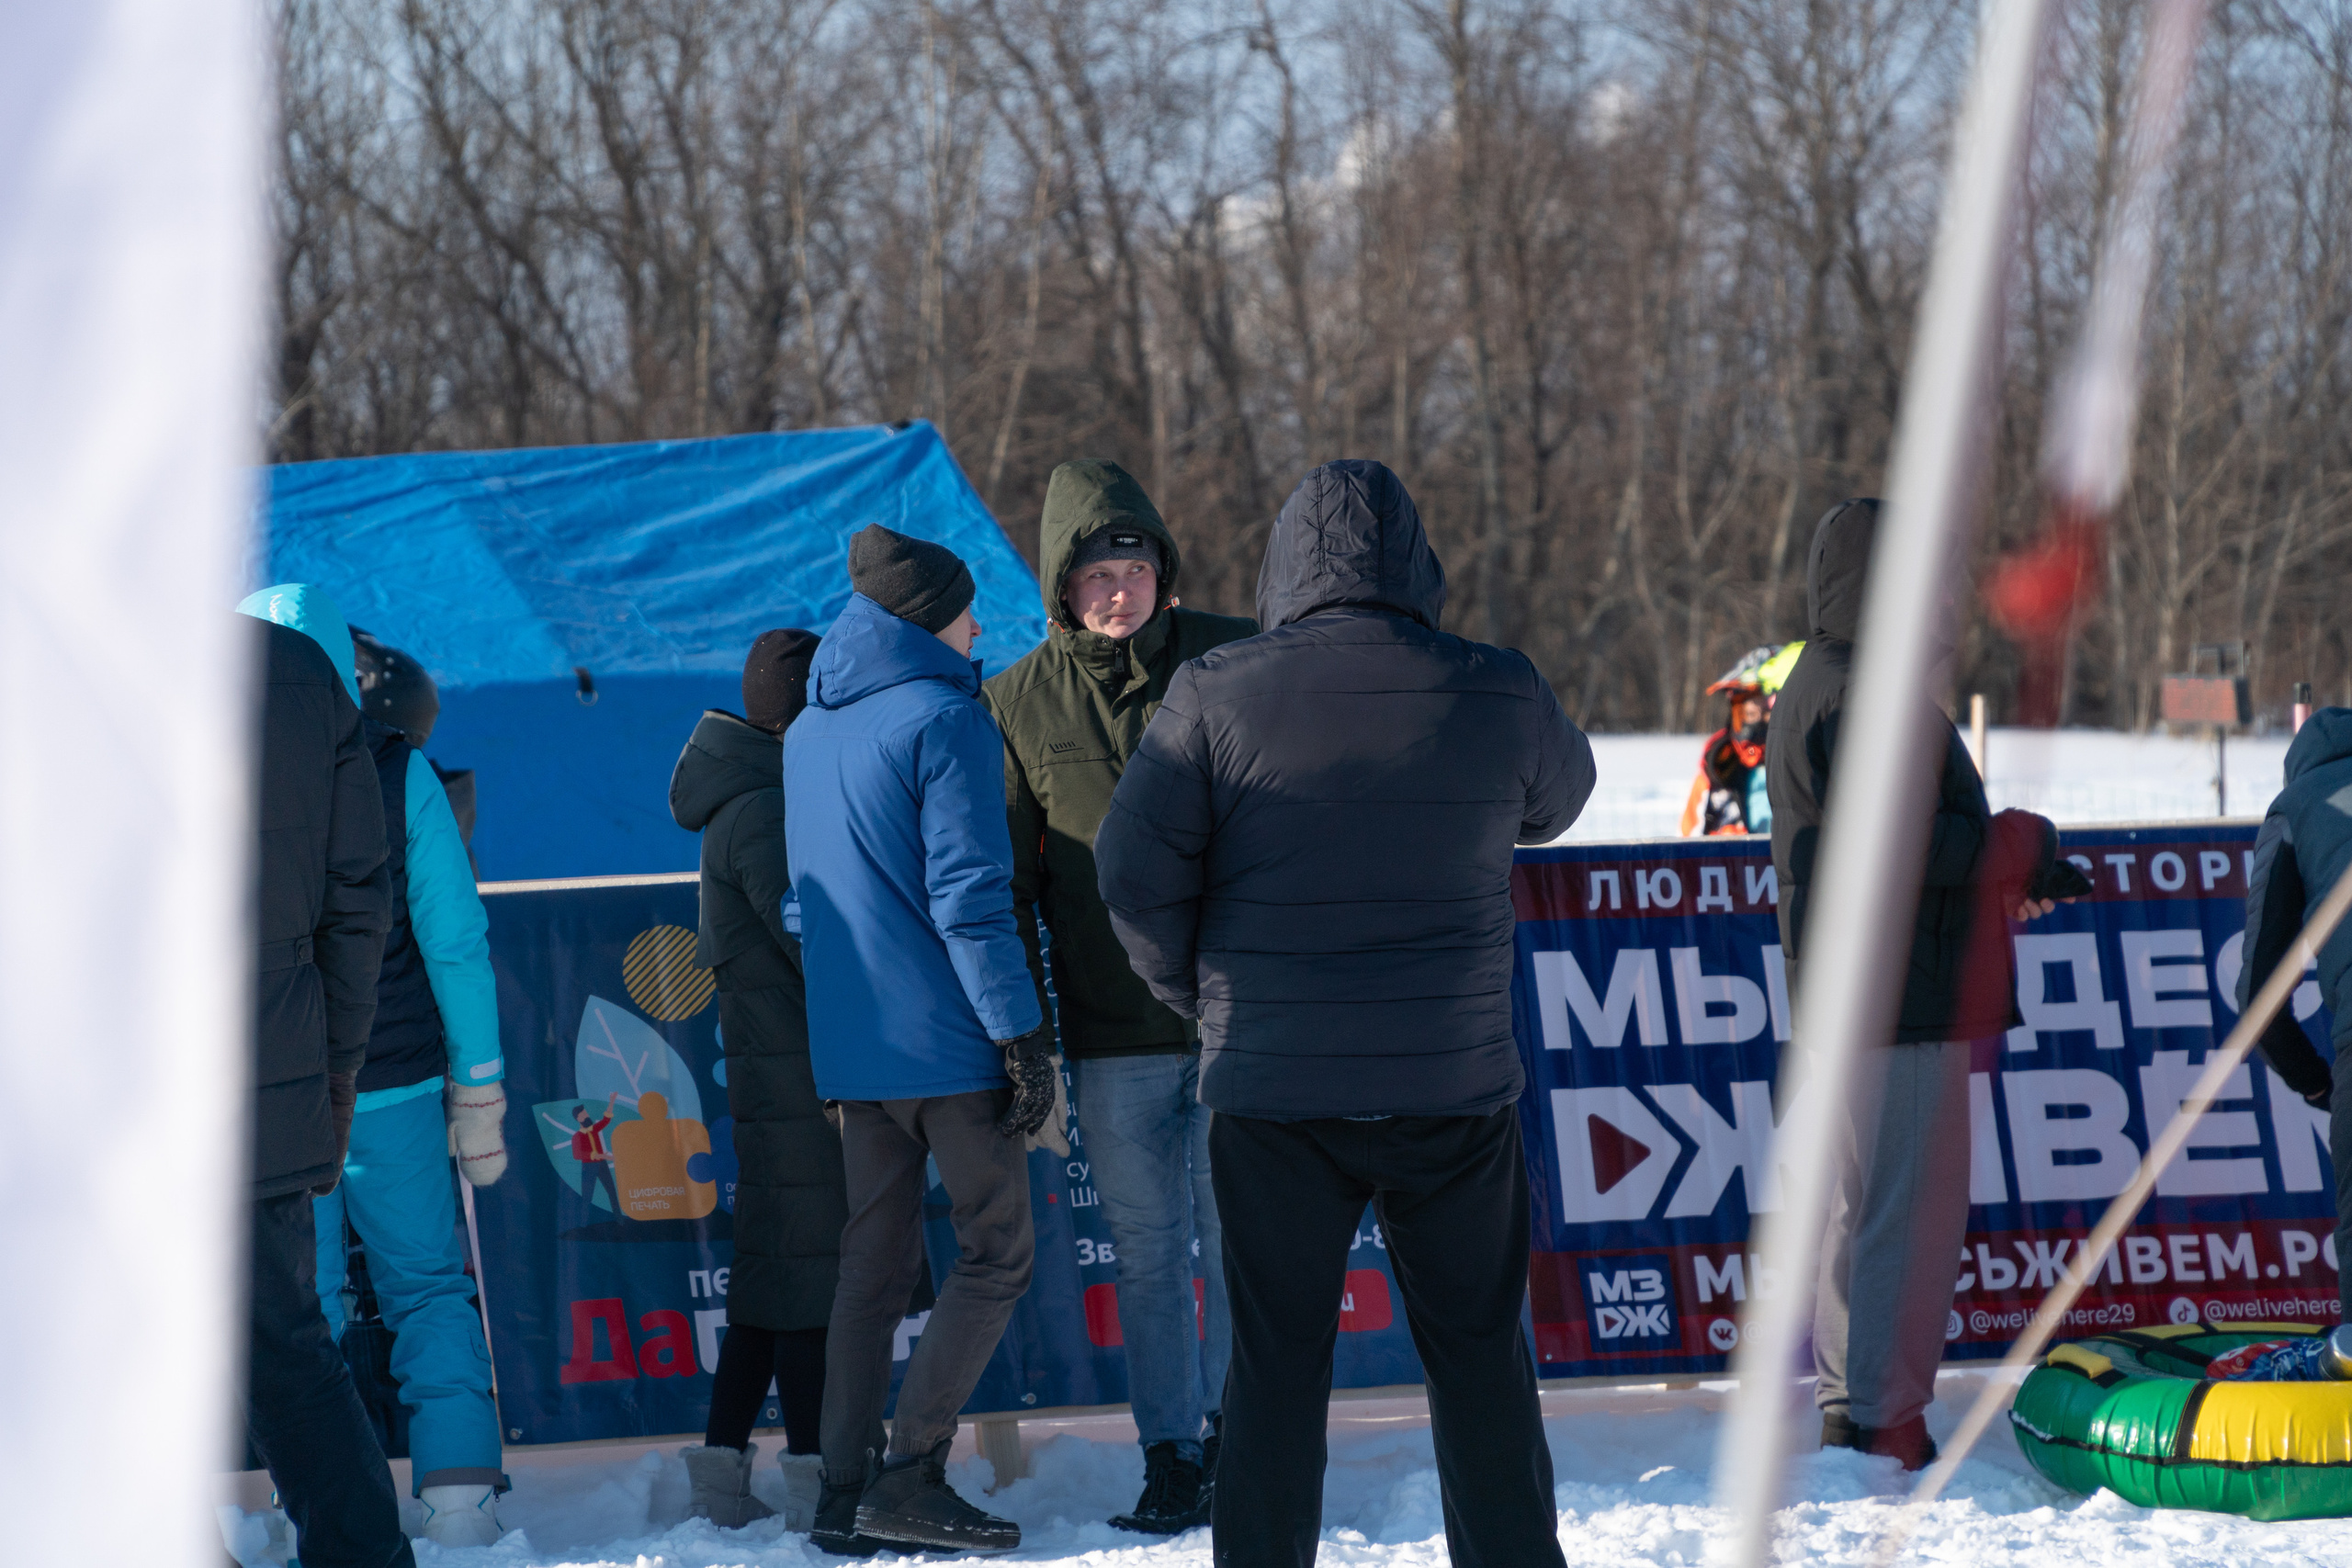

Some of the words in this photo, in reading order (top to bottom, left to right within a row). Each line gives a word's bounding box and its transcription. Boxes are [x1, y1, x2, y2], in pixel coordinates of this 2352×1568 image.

[1589, 865, 1779, 912] ЛЮДИ
[1533, 943, 1792, 1050] МЫ
[628, 1186, 685, 1199] ЦИФРОВАЯ
[630, 1200, 671, 1212] ПЕЧАТЬ
